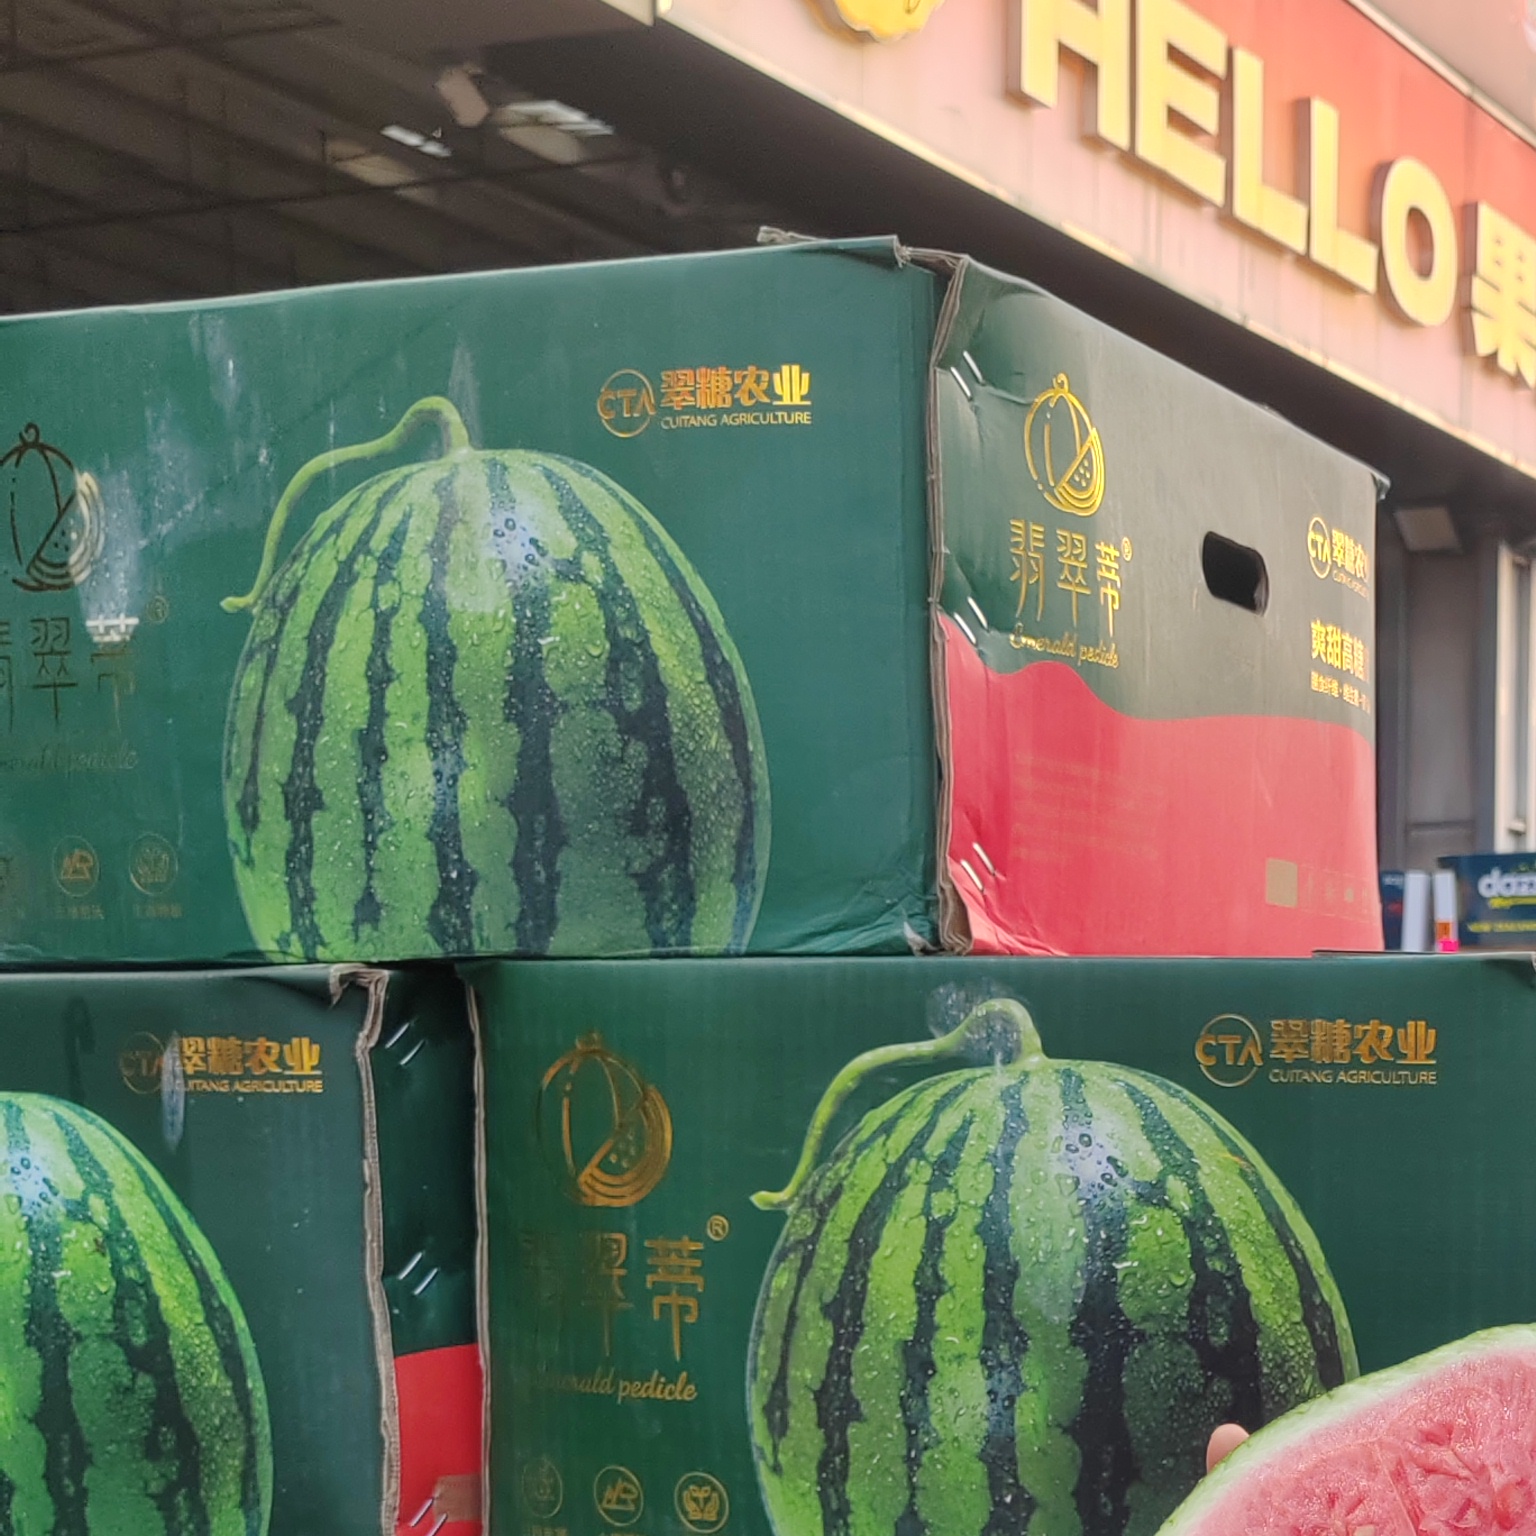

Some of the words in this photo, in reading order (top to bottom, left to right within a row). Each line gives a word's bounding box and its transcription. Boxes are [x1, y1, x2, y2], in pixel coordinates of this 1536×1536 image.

[1020, 0, 1457, 327] HELLO
[660, 364, 812, 411] 翠糖农业
[660, 413, 717, 430] CUITANG
[720, 411, 812, 427] AGRICULTURE
[1331, 528, 1370, 583] 翠糖农
[1009, 519, 1122, 638] 翡翠蒂
[1009, 622, 1076, 658] Emerald
[1310, 617, 1370, 684] 爽甜高糖
[178, 1036, 323, 1075] 翠糖农业
[1269, 1018, 1437, 1065] 翠糖农业
[233, 1079, 324, 1093] AGRICULTURE
[1268, 1069, 1333, 1084] CUITANG
[1336, 1069, 1438, 1085] AGRICULTURE
[617, 1368, 698, 1405] pedicle
